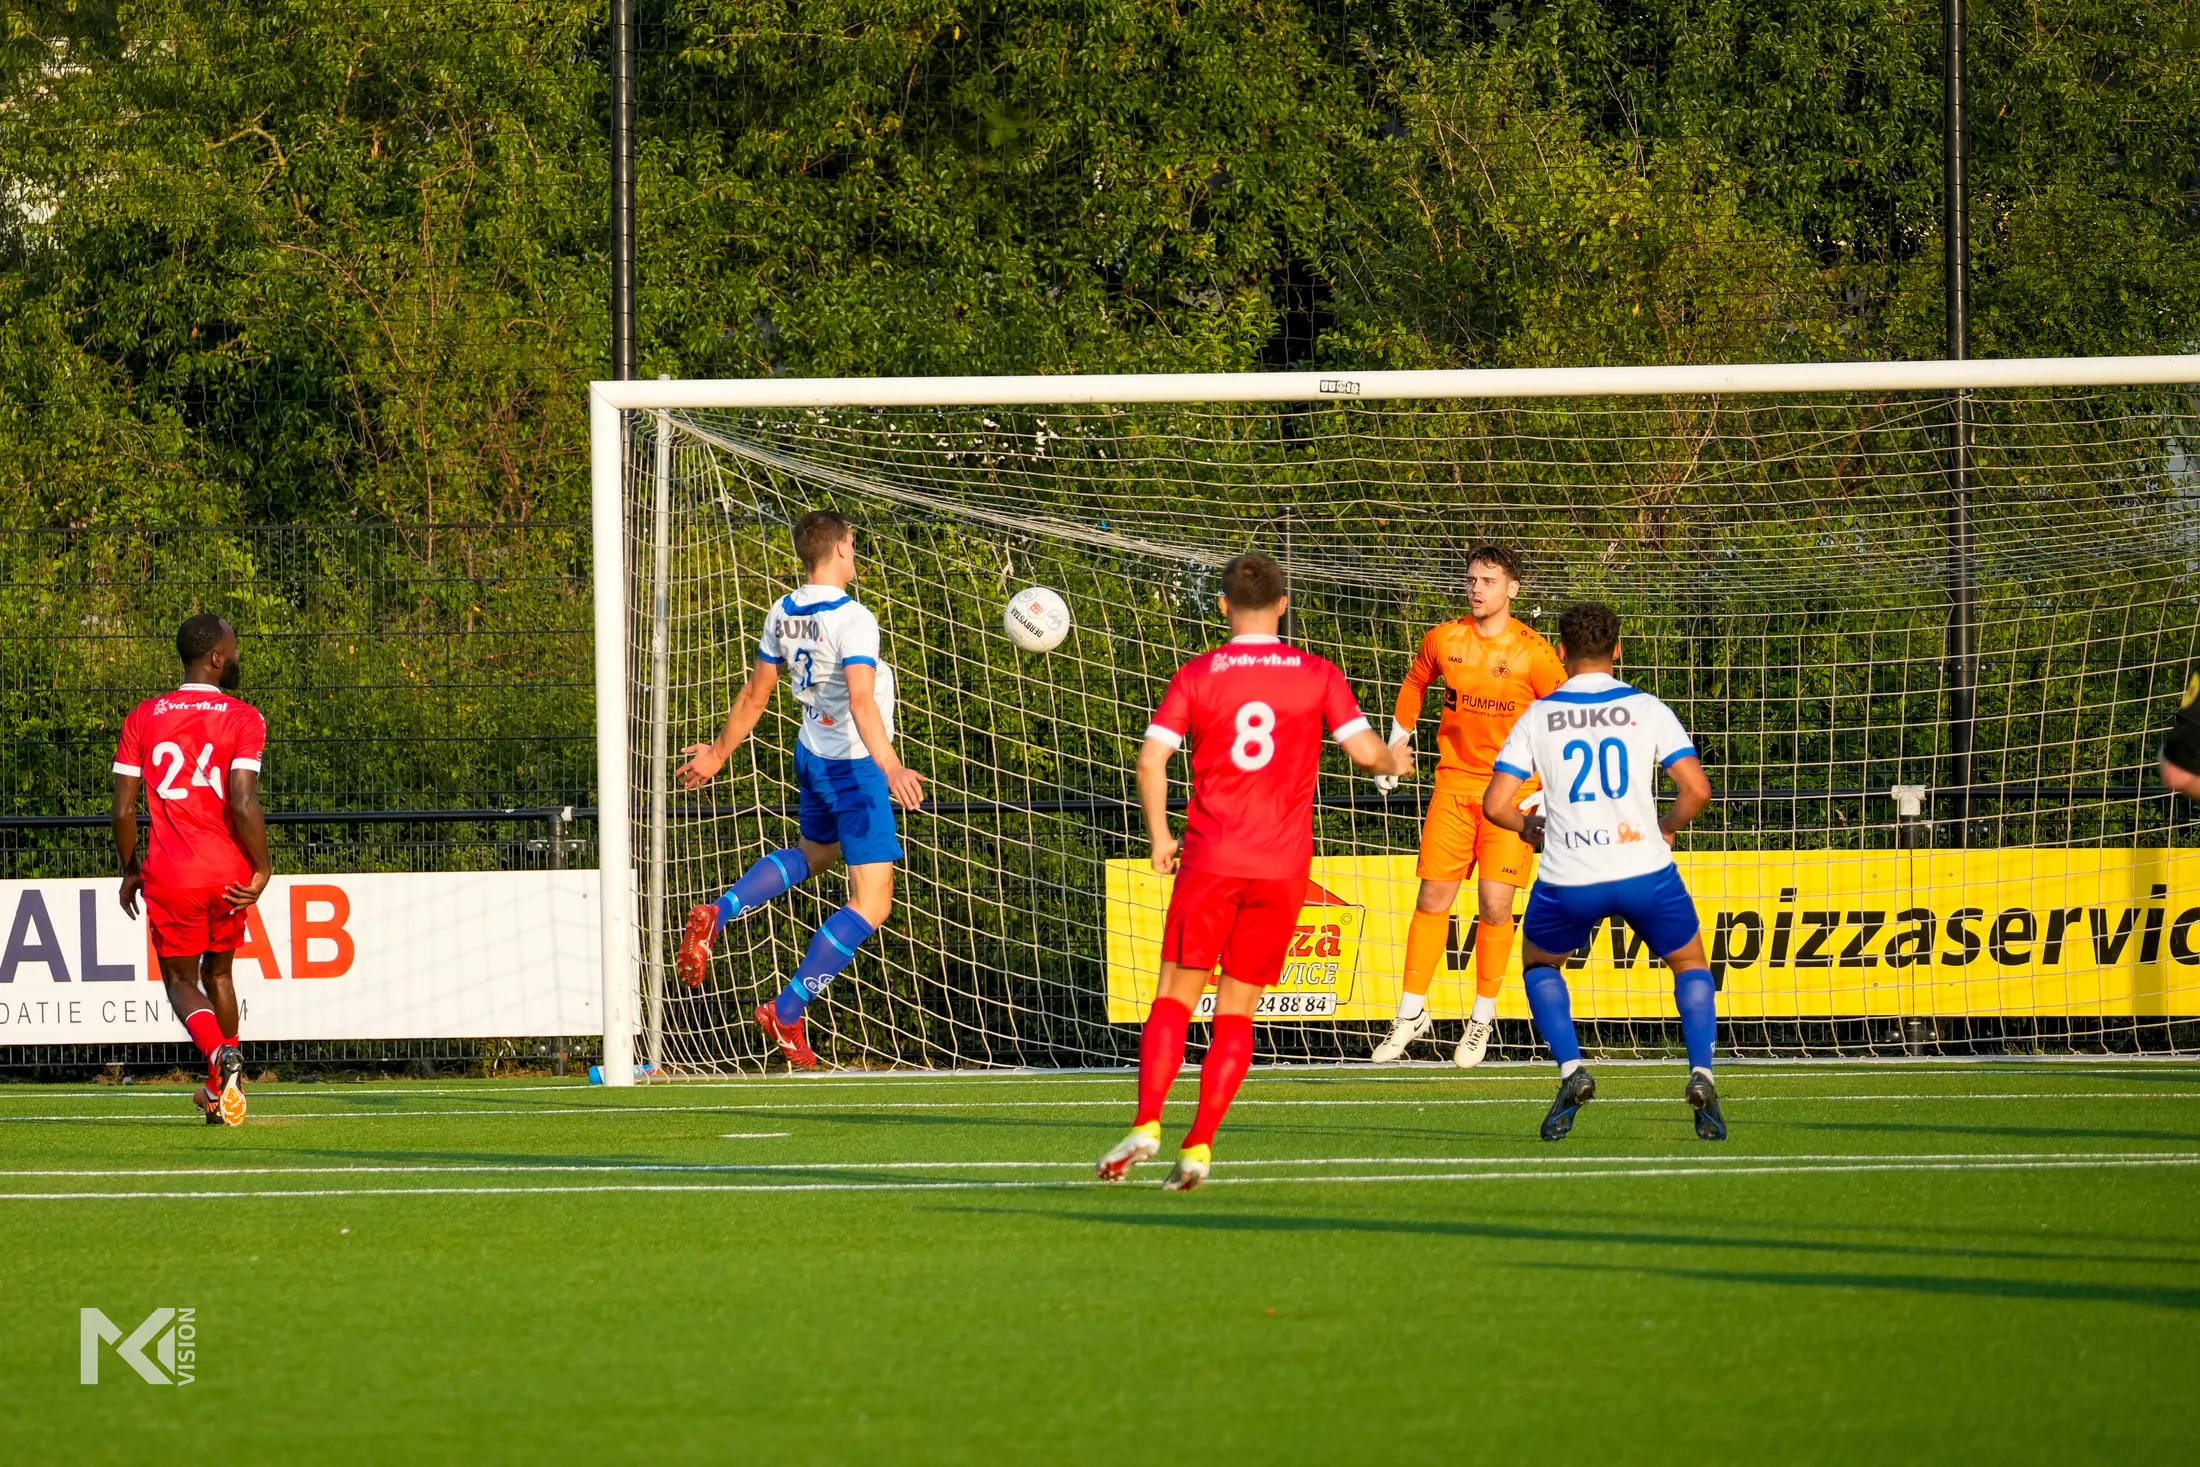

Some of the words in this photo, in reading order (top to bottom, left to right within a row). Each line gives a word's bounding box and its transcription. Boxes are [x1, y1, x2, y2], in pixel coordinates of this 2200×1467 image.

[1010, 606, 1045, 638] DERBYSTAR
[1447, 655, 1463, 664] JAKO
[168, 700, 228, 713] vdv-vh.nl
[1461, 694, 1516, 712] RUMPING
[1547, 705, 1637, 732] BUKO.
[1231, 700, 1276, 771] 8
[152, 741, 224, 800] 24
[1562, 736, 1630, 804] 20
[1564, 829, 1611, 849] ING
[1501, 866, 1518, 875] JAKO
